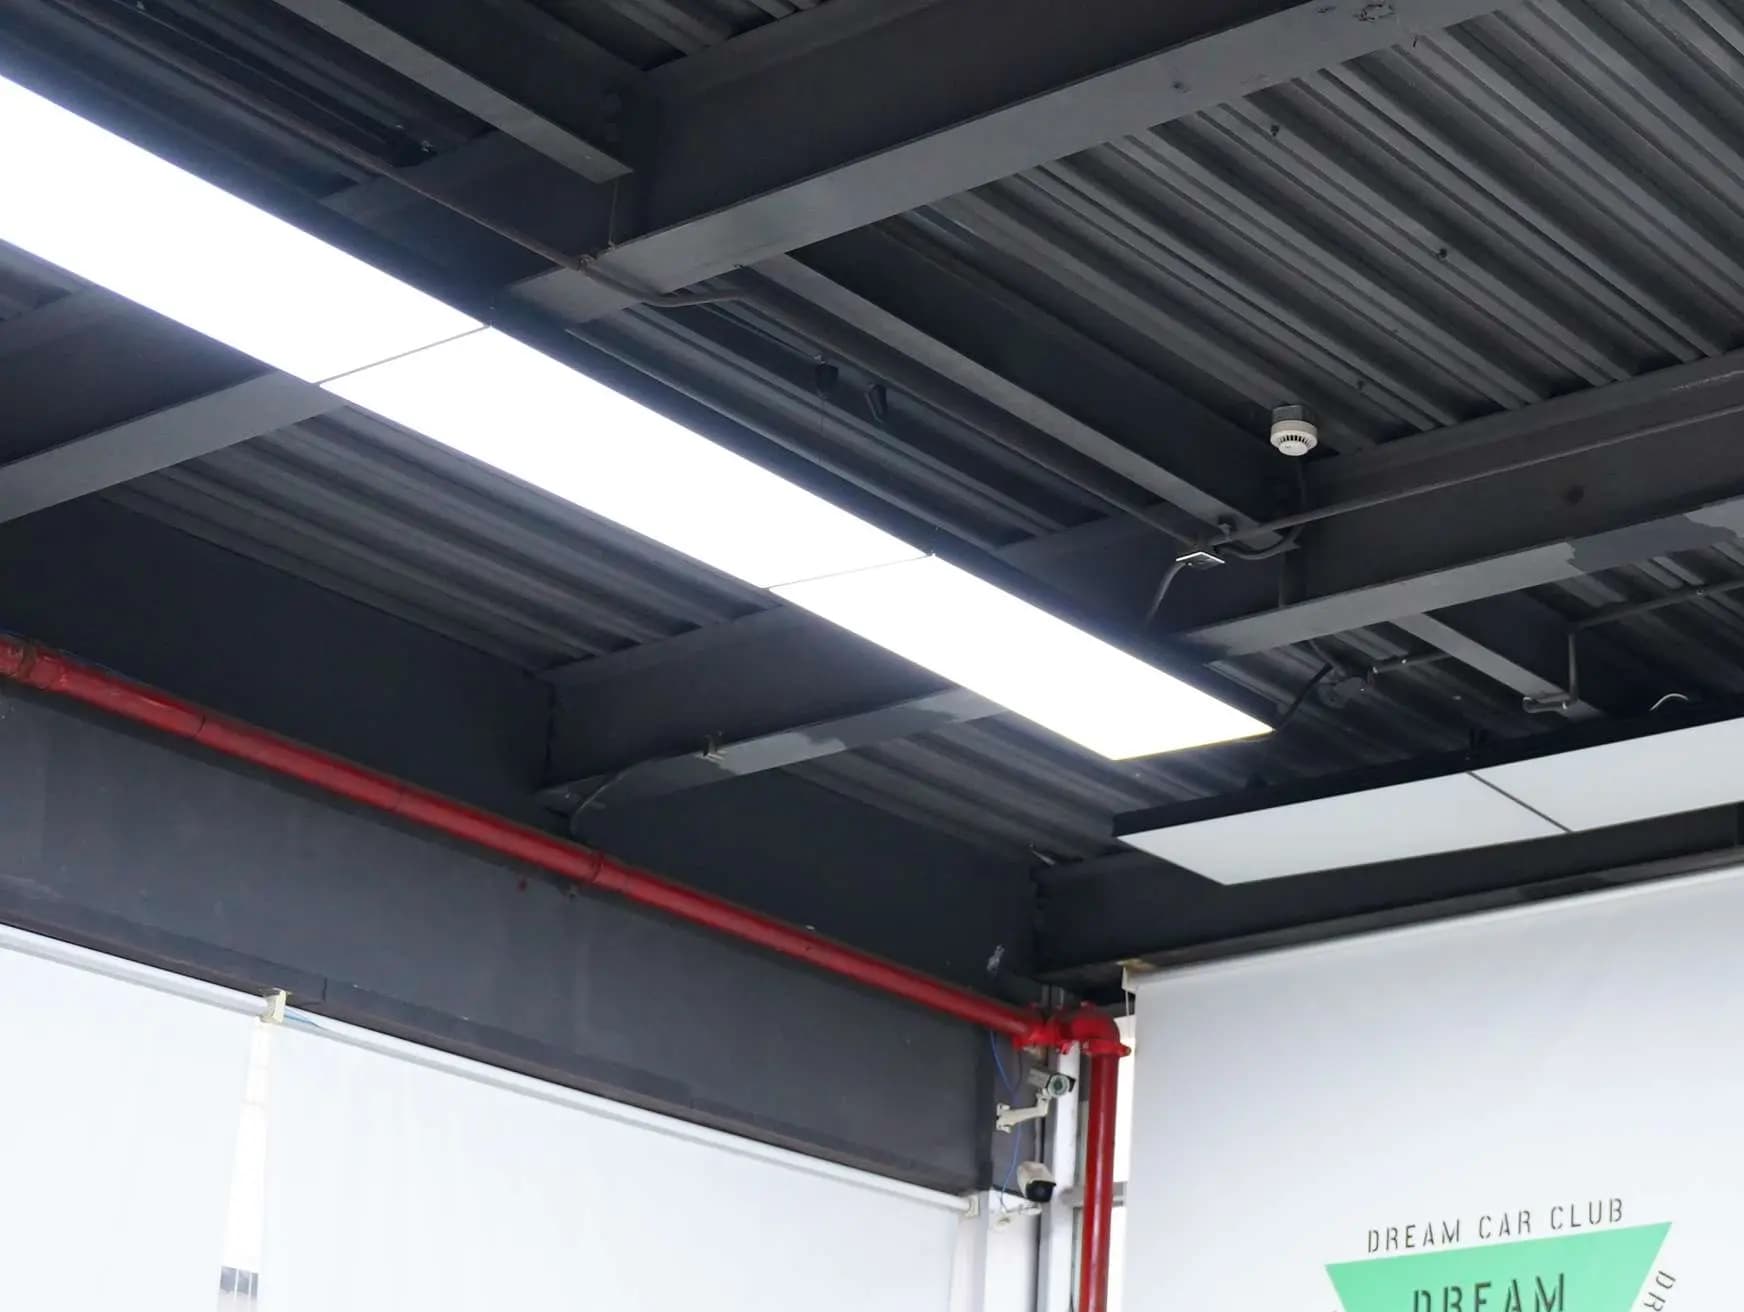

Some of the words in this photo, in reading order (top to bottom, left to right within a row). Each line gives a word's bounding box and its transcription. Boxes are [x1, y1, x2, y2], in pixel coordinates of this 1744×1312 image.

[1368, 1218, 1460, 1254] DREAM
[1478, 1209, 1531, 1240] CAR
[1550, 1197, 1624, 1231] CLUB
